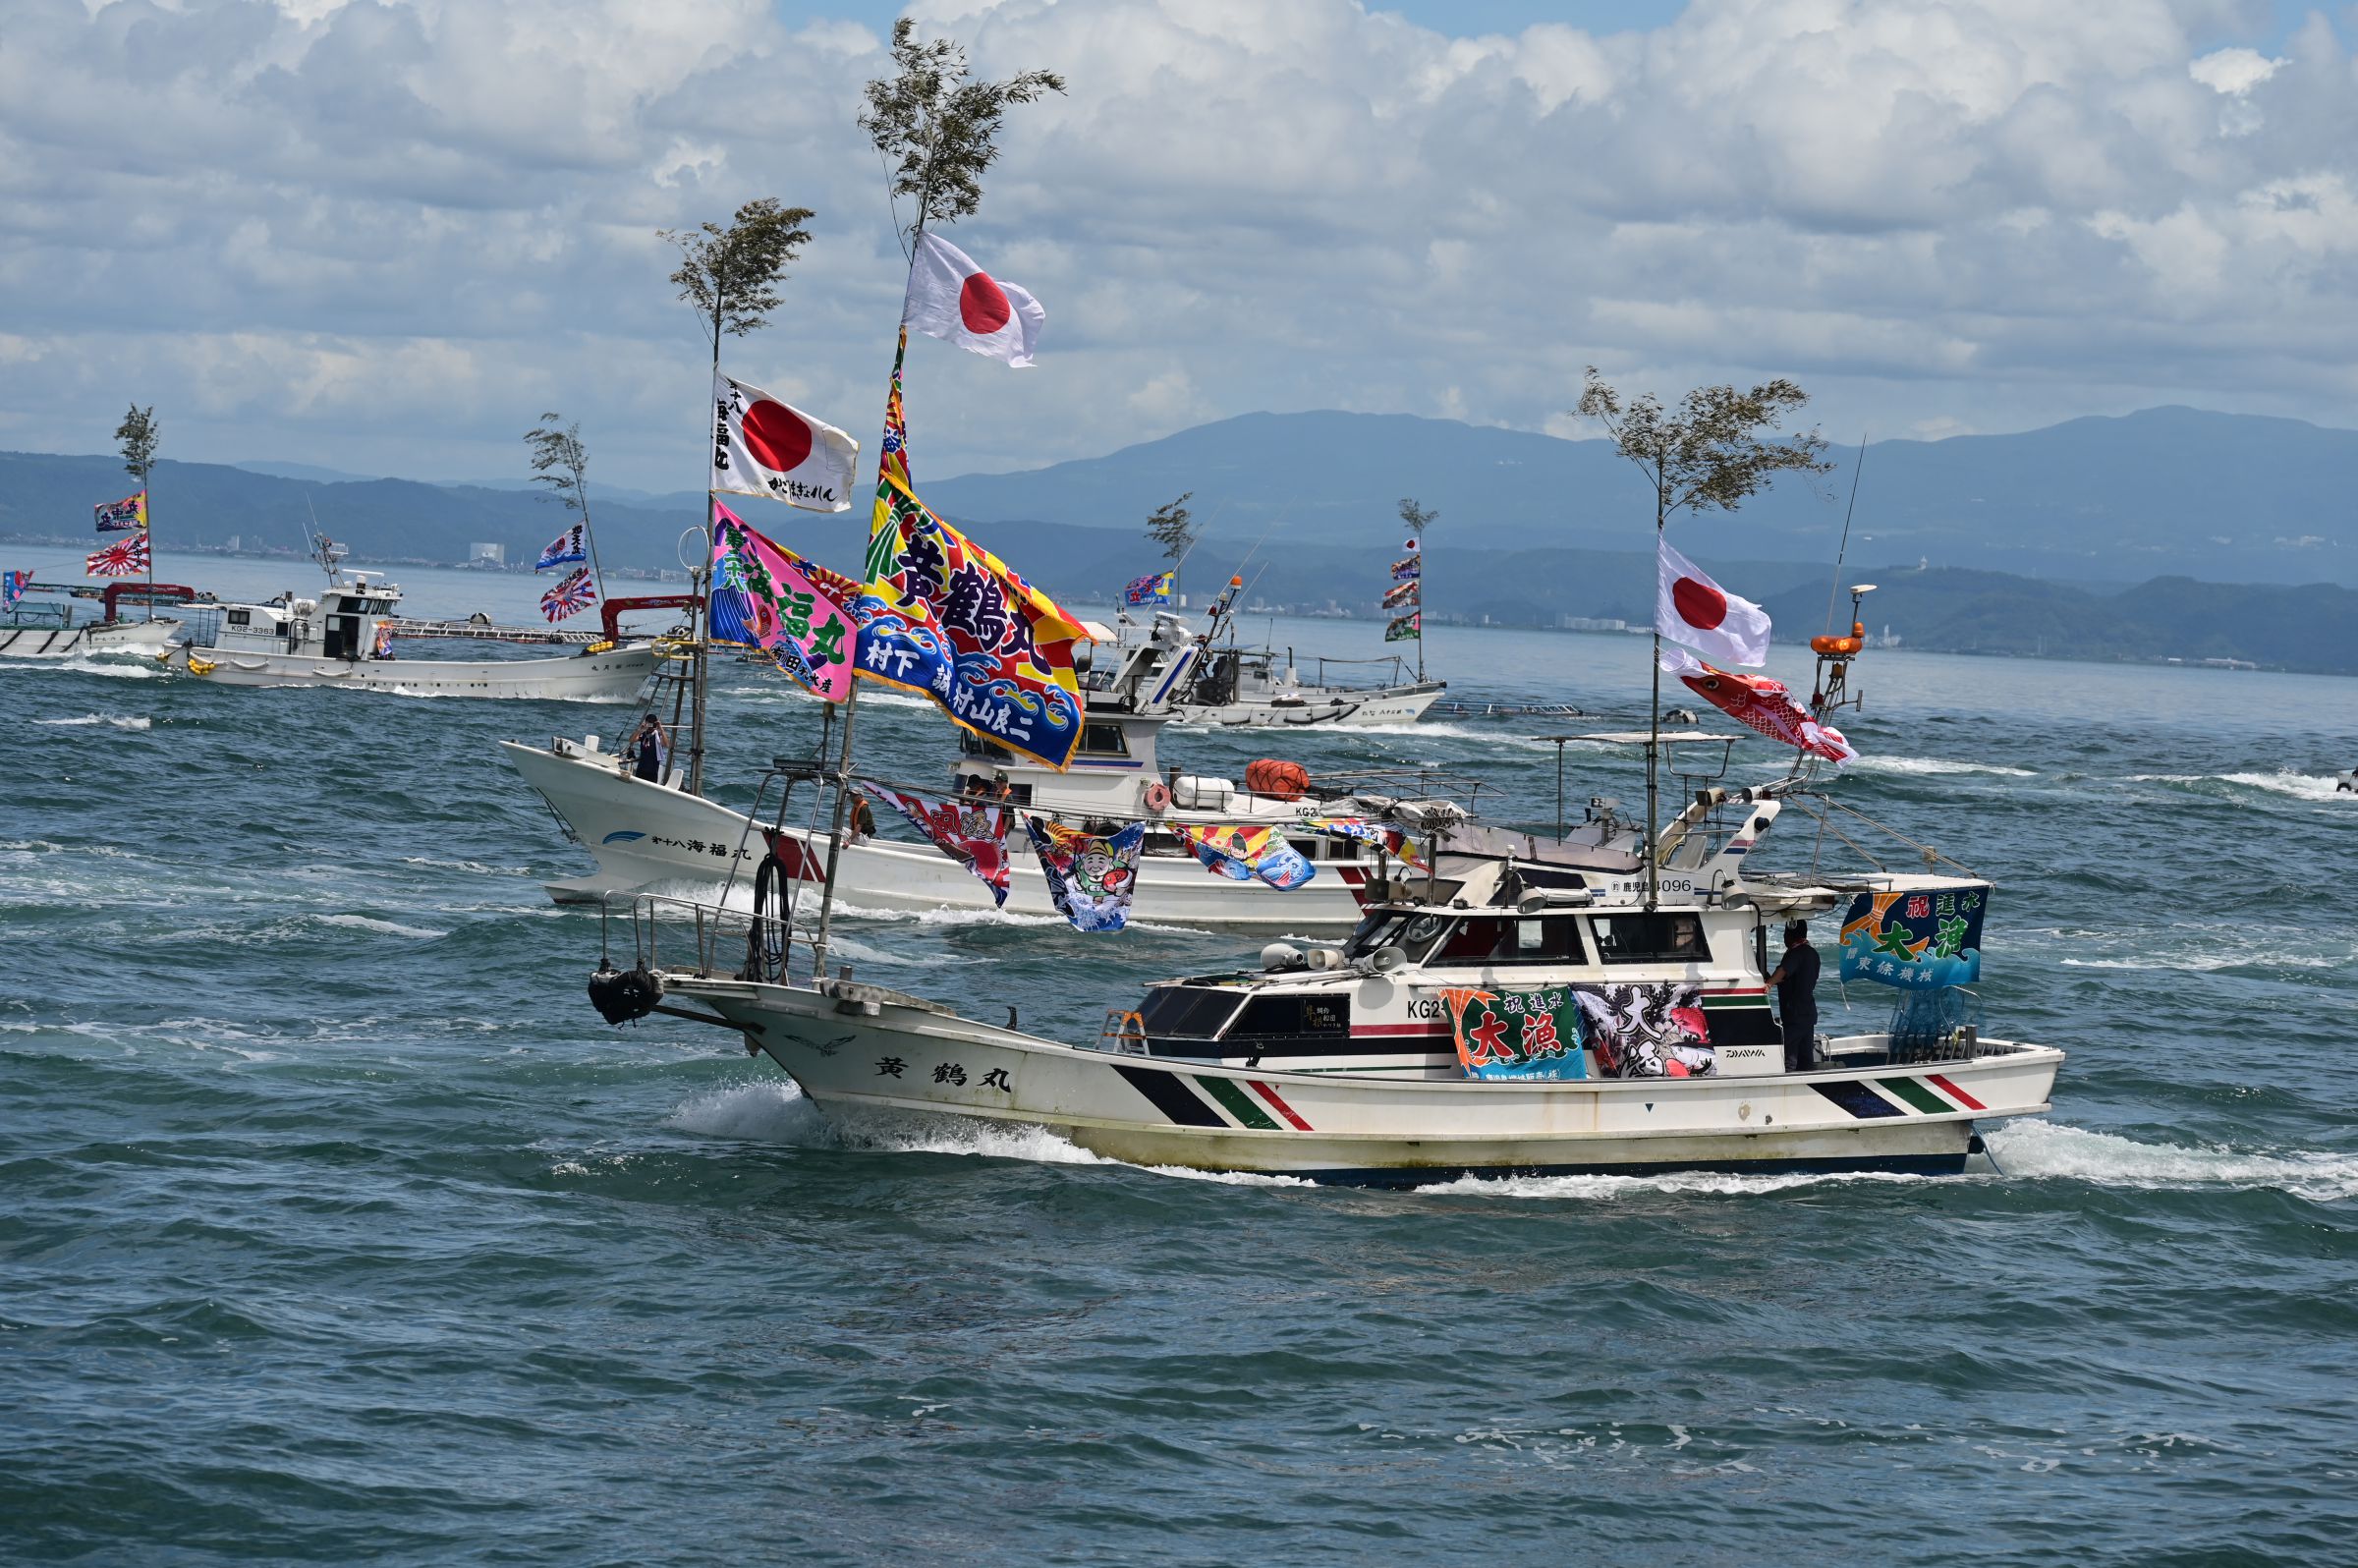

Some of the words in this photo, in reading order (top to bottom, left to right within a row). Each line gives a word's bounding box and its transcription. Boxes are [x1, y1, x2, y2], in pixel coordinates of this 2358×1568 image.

[866, 639, 920, 678] 村下
[1872, 915, 1969, 963] 大漁
[1503, 991, 1564, 1014] 祝進水
[1469, 1010, 1562, 1058] 大漁
[874, 1057, 1011, 1092] 黄鶴丸
